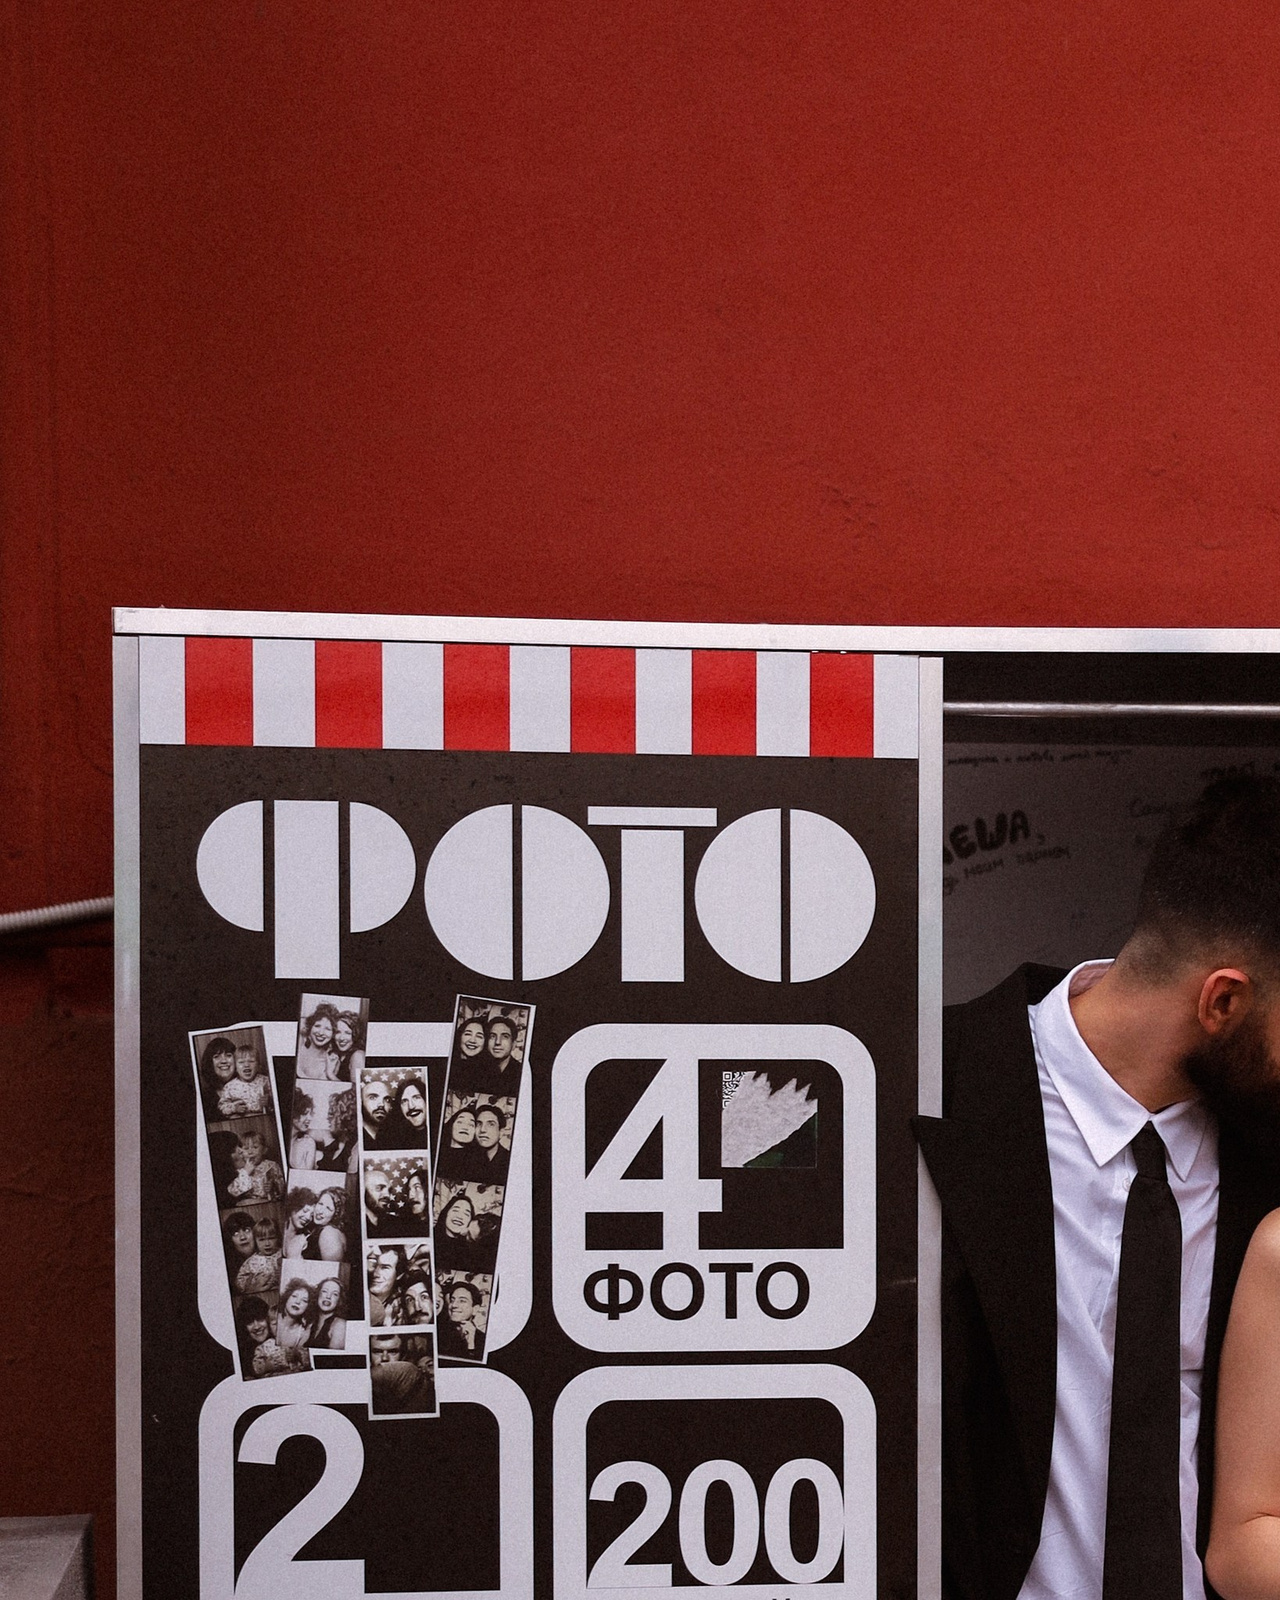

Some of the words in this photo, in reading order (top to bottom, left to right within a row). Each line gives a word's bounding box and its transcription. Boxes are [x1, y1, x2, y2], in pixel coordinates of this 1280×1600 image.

[196, 799, 877, 983] ФОТО
[584, 1057, 723, 1251] 4
[583, 1261, 810, 1321] ФОТО
[234, 1403, 365, 1596] 2
[586, 1458, 845, 1588] 200
